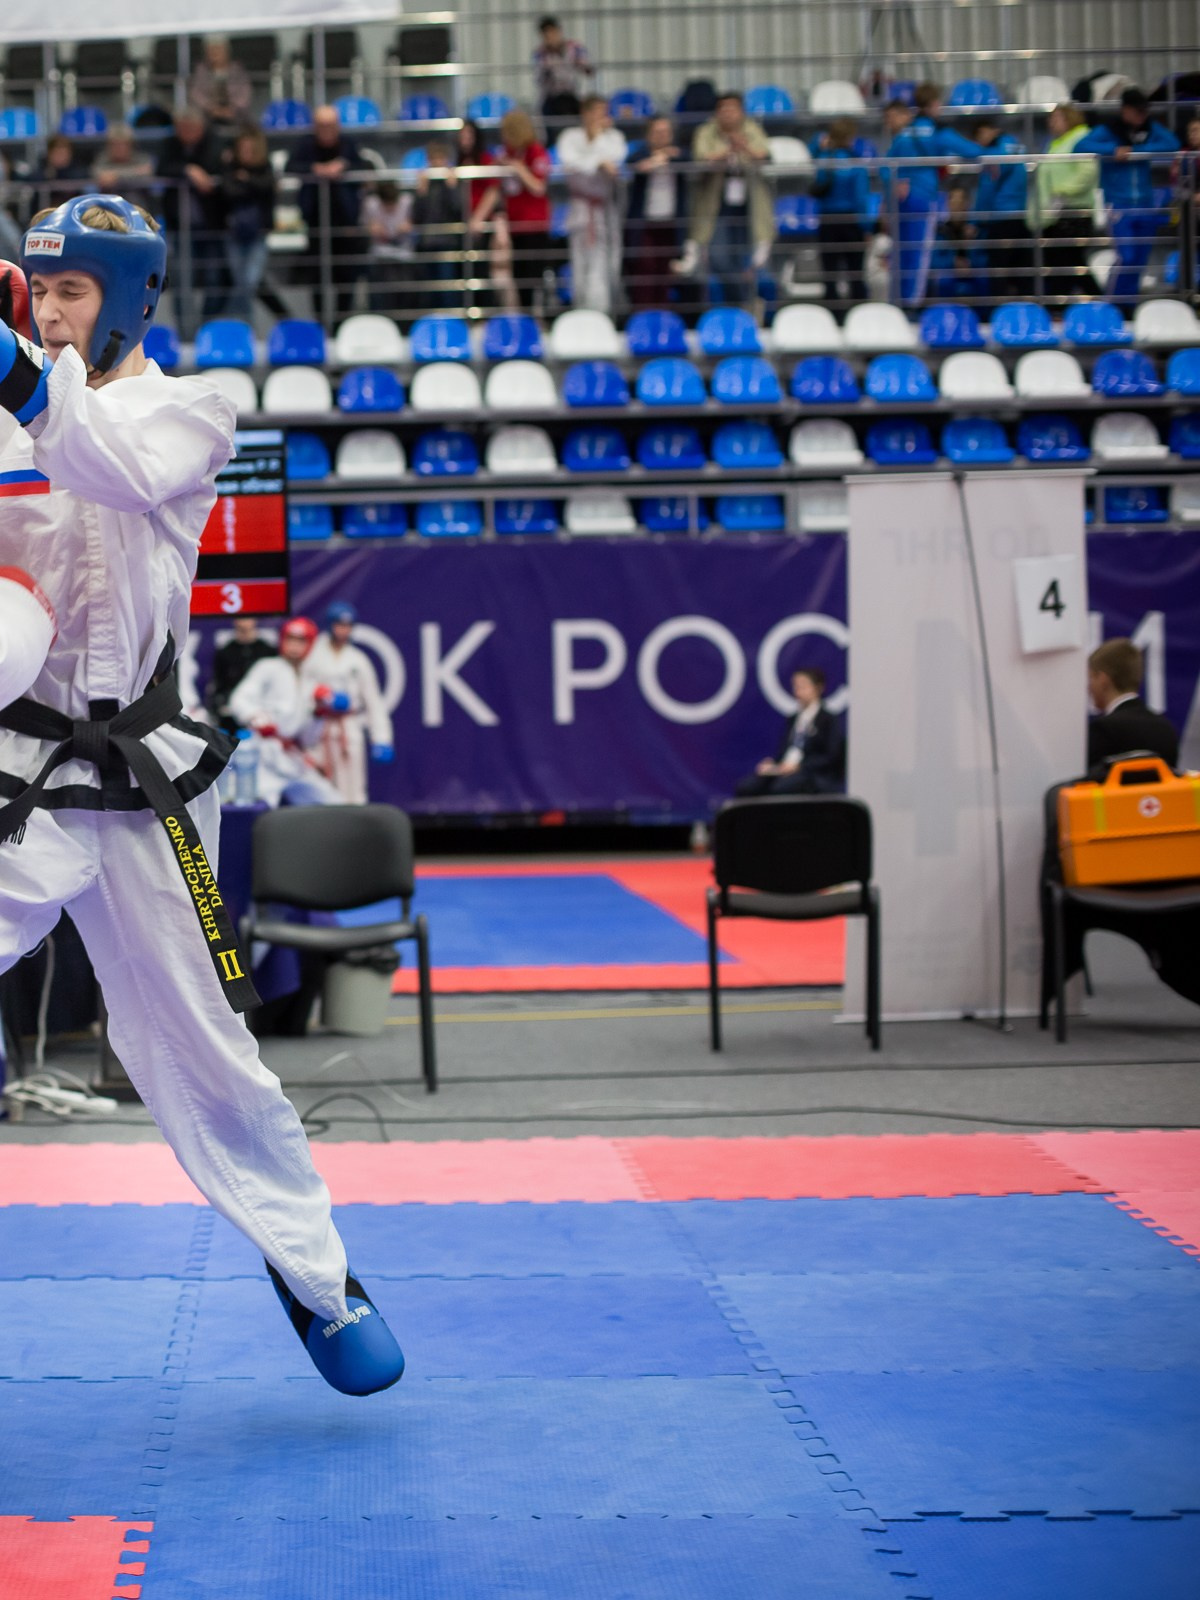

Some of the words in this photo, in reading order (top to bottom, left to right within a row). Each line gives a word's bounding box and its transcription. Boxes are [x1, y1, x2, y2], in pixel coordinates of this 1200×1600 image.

[27, 240, 41, 249] TOP
[220, 583, 243, 614] 3
[1038, 578, 1067, 620] 4
[165, 816, 222, 942] KHRYPCHENKO
[191, 843, 223, 908] DANILA
[217, 948, 245, 982] II
